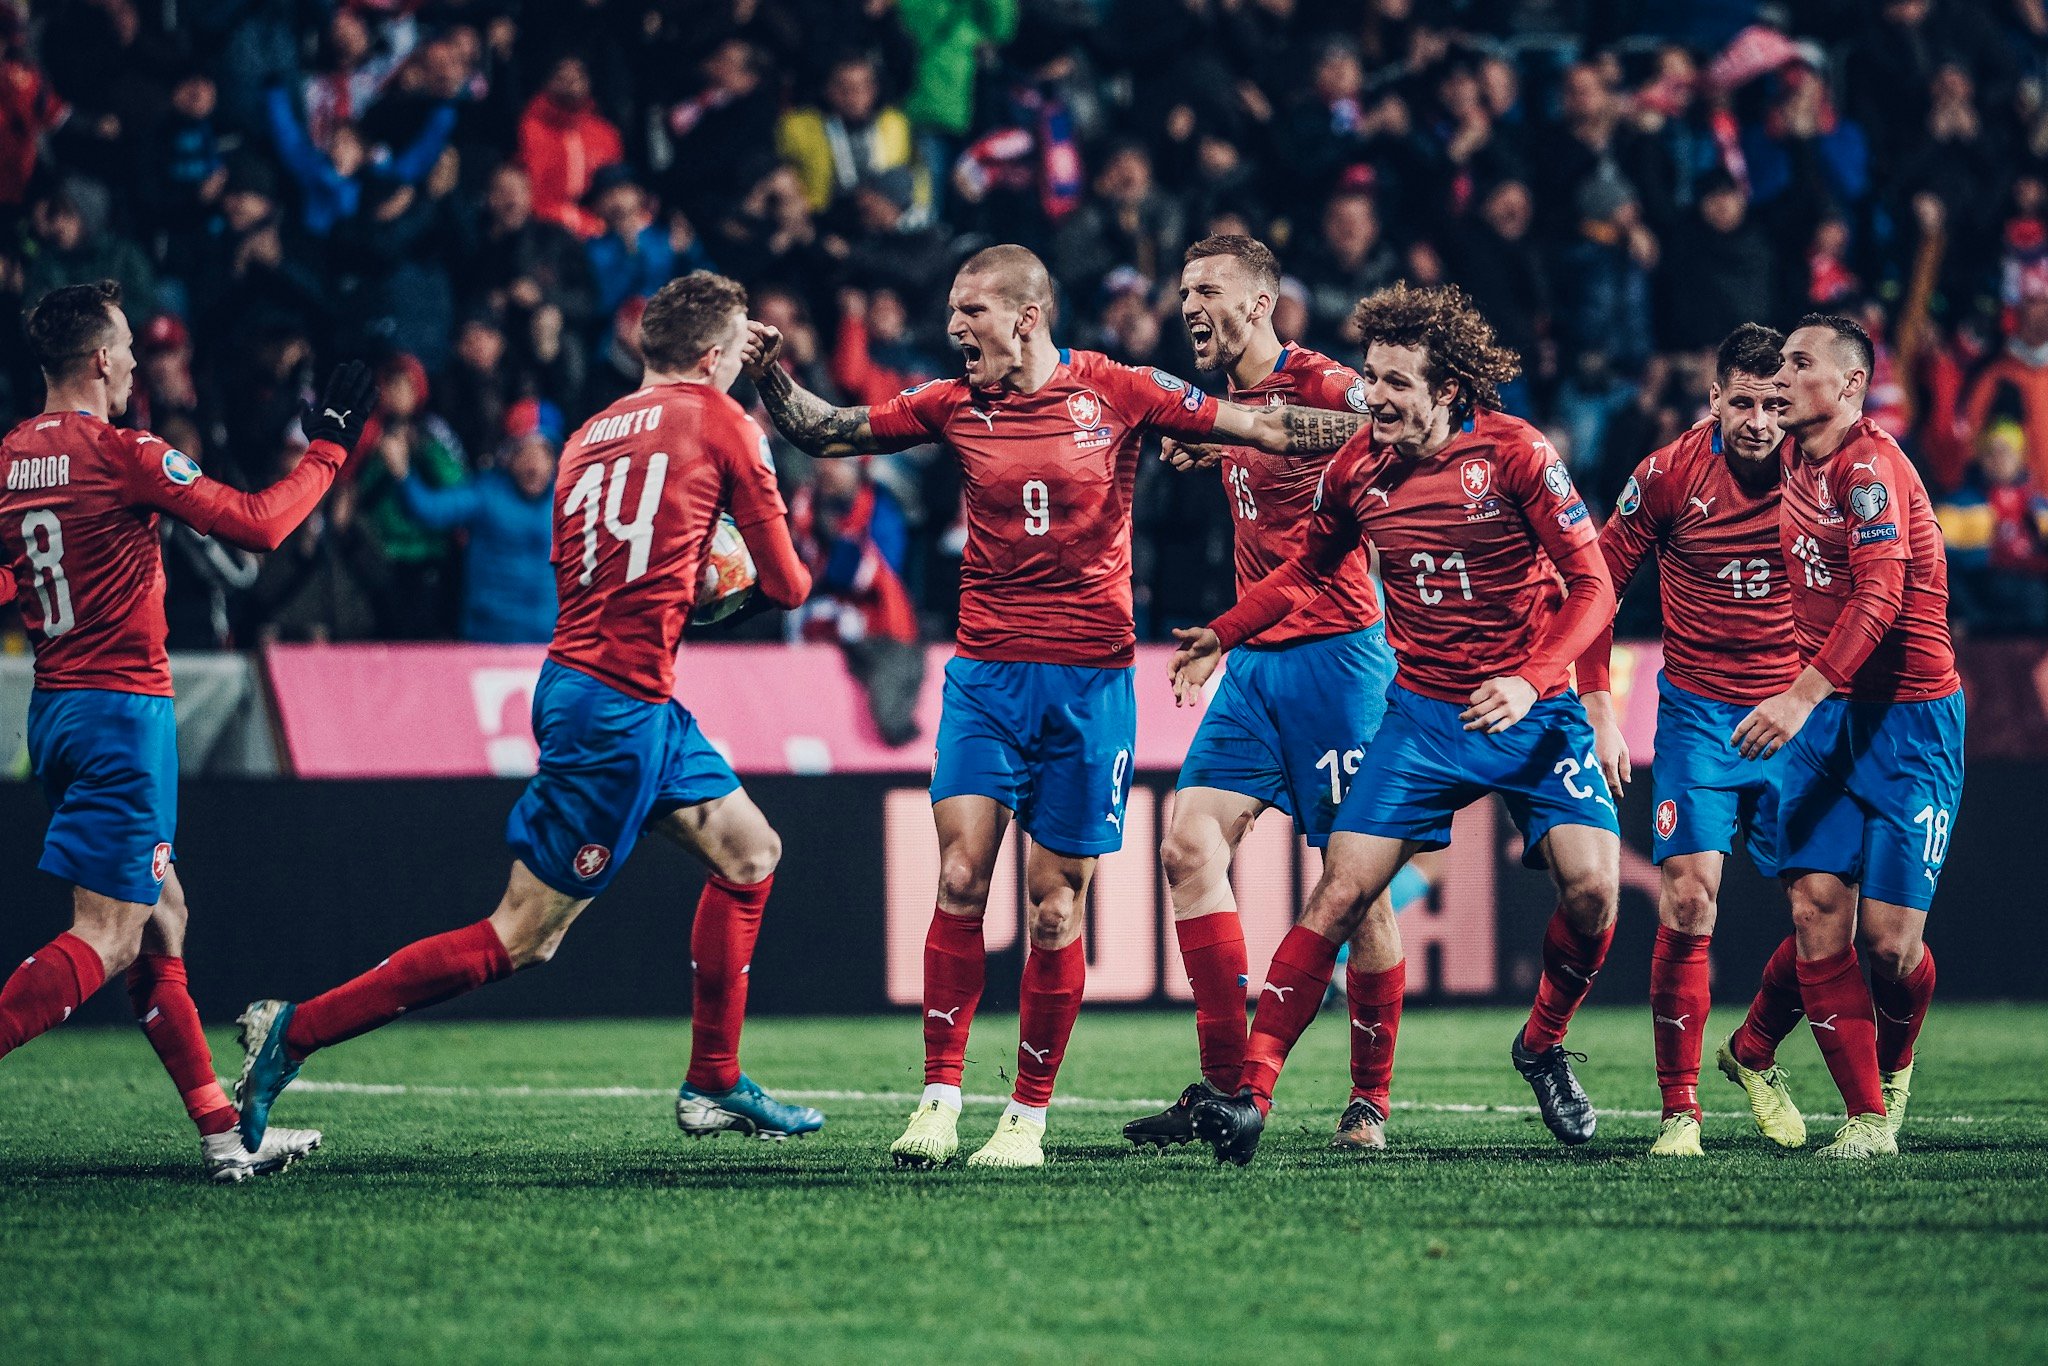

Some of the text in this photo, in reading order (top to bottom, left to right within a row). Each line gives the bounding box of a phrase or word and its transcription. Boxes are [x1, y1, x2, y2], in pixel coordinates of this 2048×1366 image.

[581, 405, 663, 447] JANKTO
[7, 454, 70, 490] DARIDA
[563, 452, 669, 586] 14
[1022, 479, 1050, 536] 9
[1861, 527, 1896, 539] RESPECT
[21, 509, 75, 639] 8
[1410, 551, 1474, 605] 21
[1716, 558, 1770, 598] 12
[1111, 749, 1129, 807] 9
[1913, 804, 1950, 864] 18
